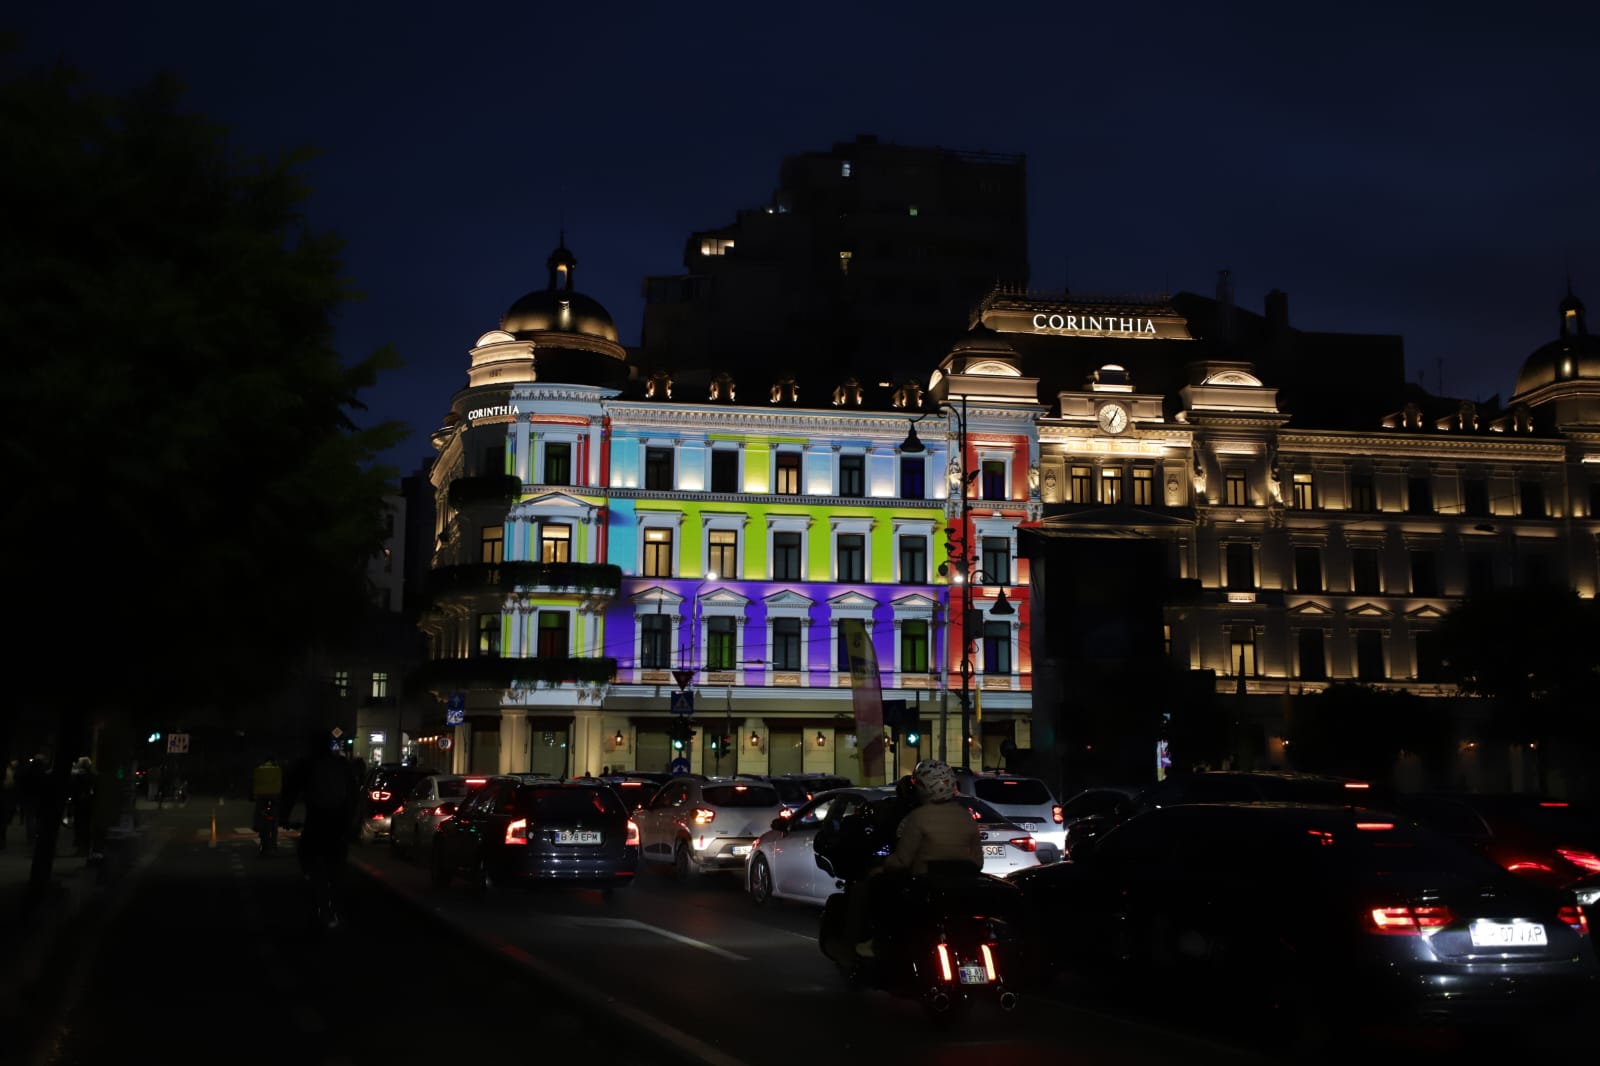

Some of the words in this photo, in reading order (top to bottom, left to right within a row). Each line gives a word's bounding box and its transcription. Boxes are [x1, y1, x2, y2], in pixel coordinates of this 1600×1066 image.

[1032, 313, 1156, 333] CORINTHIA
[468, 405, 520, 420] CORINTHIA
[561, 832, 567, 841] B
[581, 832, 598, 842] EPM
[986, 846, 1004, 856] SOE
